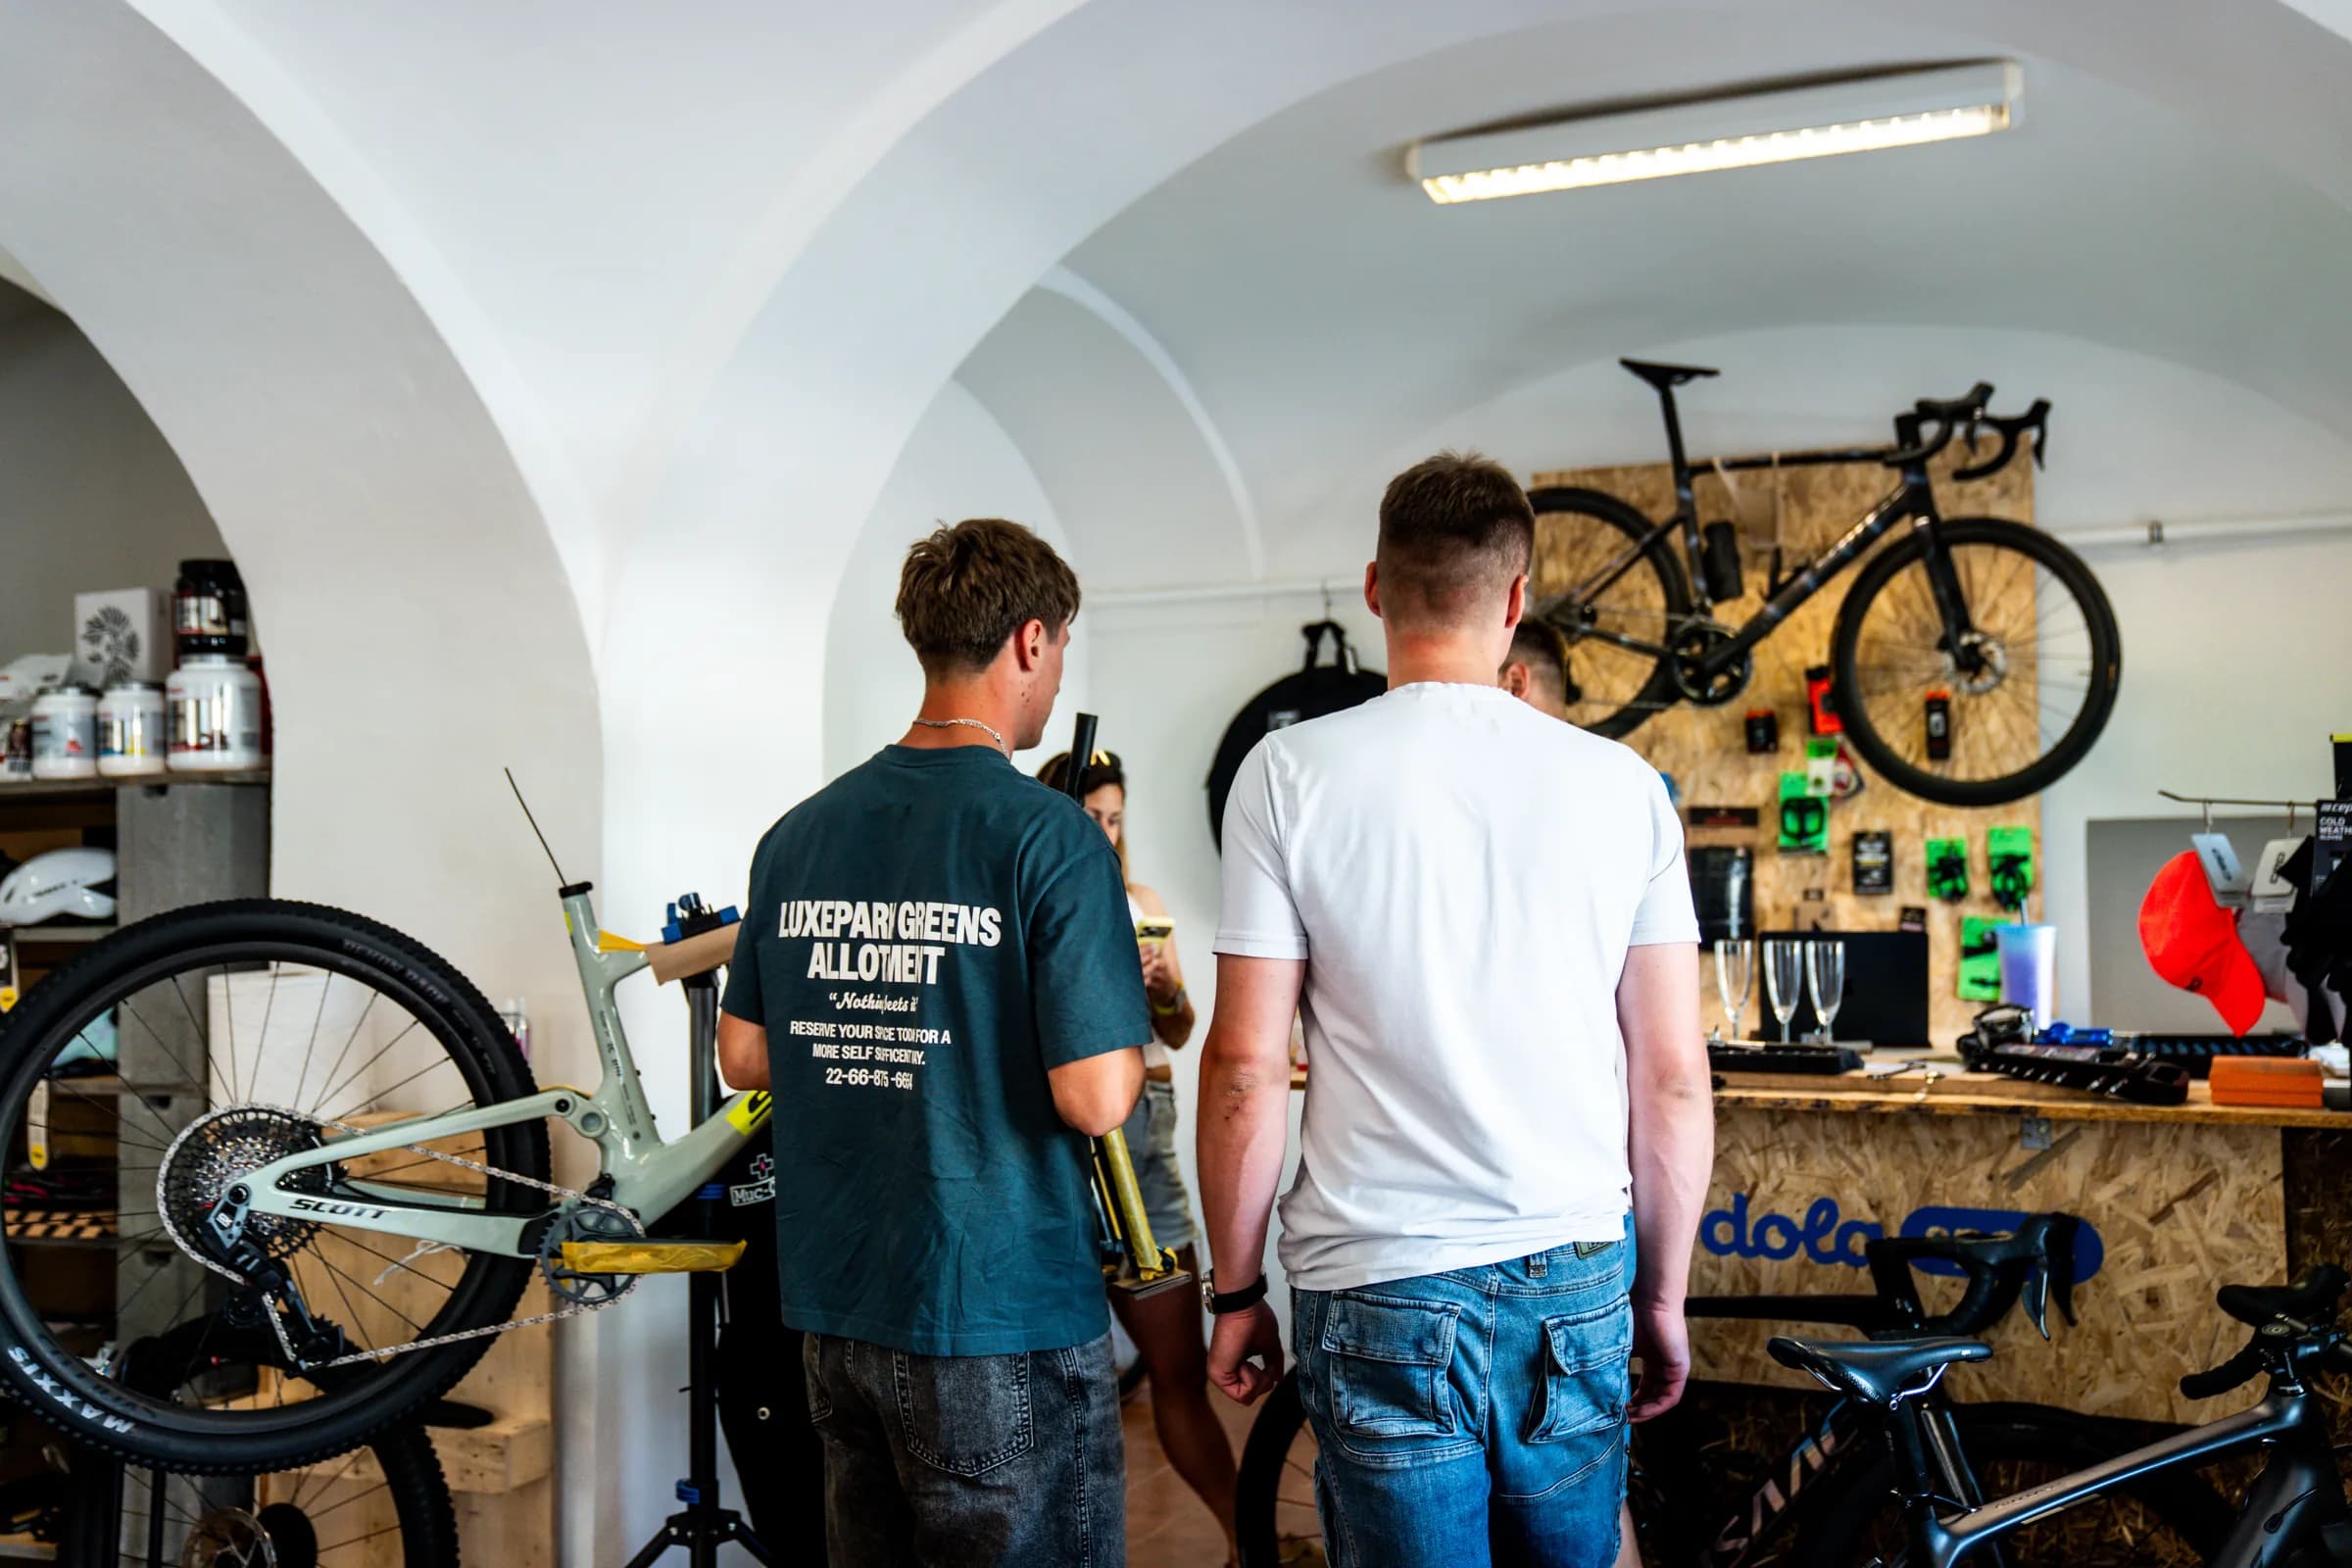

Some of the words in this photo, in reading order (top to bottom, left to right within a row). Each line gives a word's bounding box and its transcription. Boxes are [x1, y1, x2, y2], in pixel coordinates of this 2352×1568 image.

[2320, 816, 2345, 826] COLD
[898, 901, 1003, 948] GREENS
[790, 1020, 837, 1038] RESERVE
[838, 1023, 874, 1040] YOUR
[915, 1029, 939, 1044] FOR
[940, 1029, 952, 1045] A
[812, 1043, 840, 1059] MORE
[841, 1045, 874, 1060] SELF
[289, 1198, 392, 1220] SCOTT
[7, 1346, 136, 1434] MAXXIS
